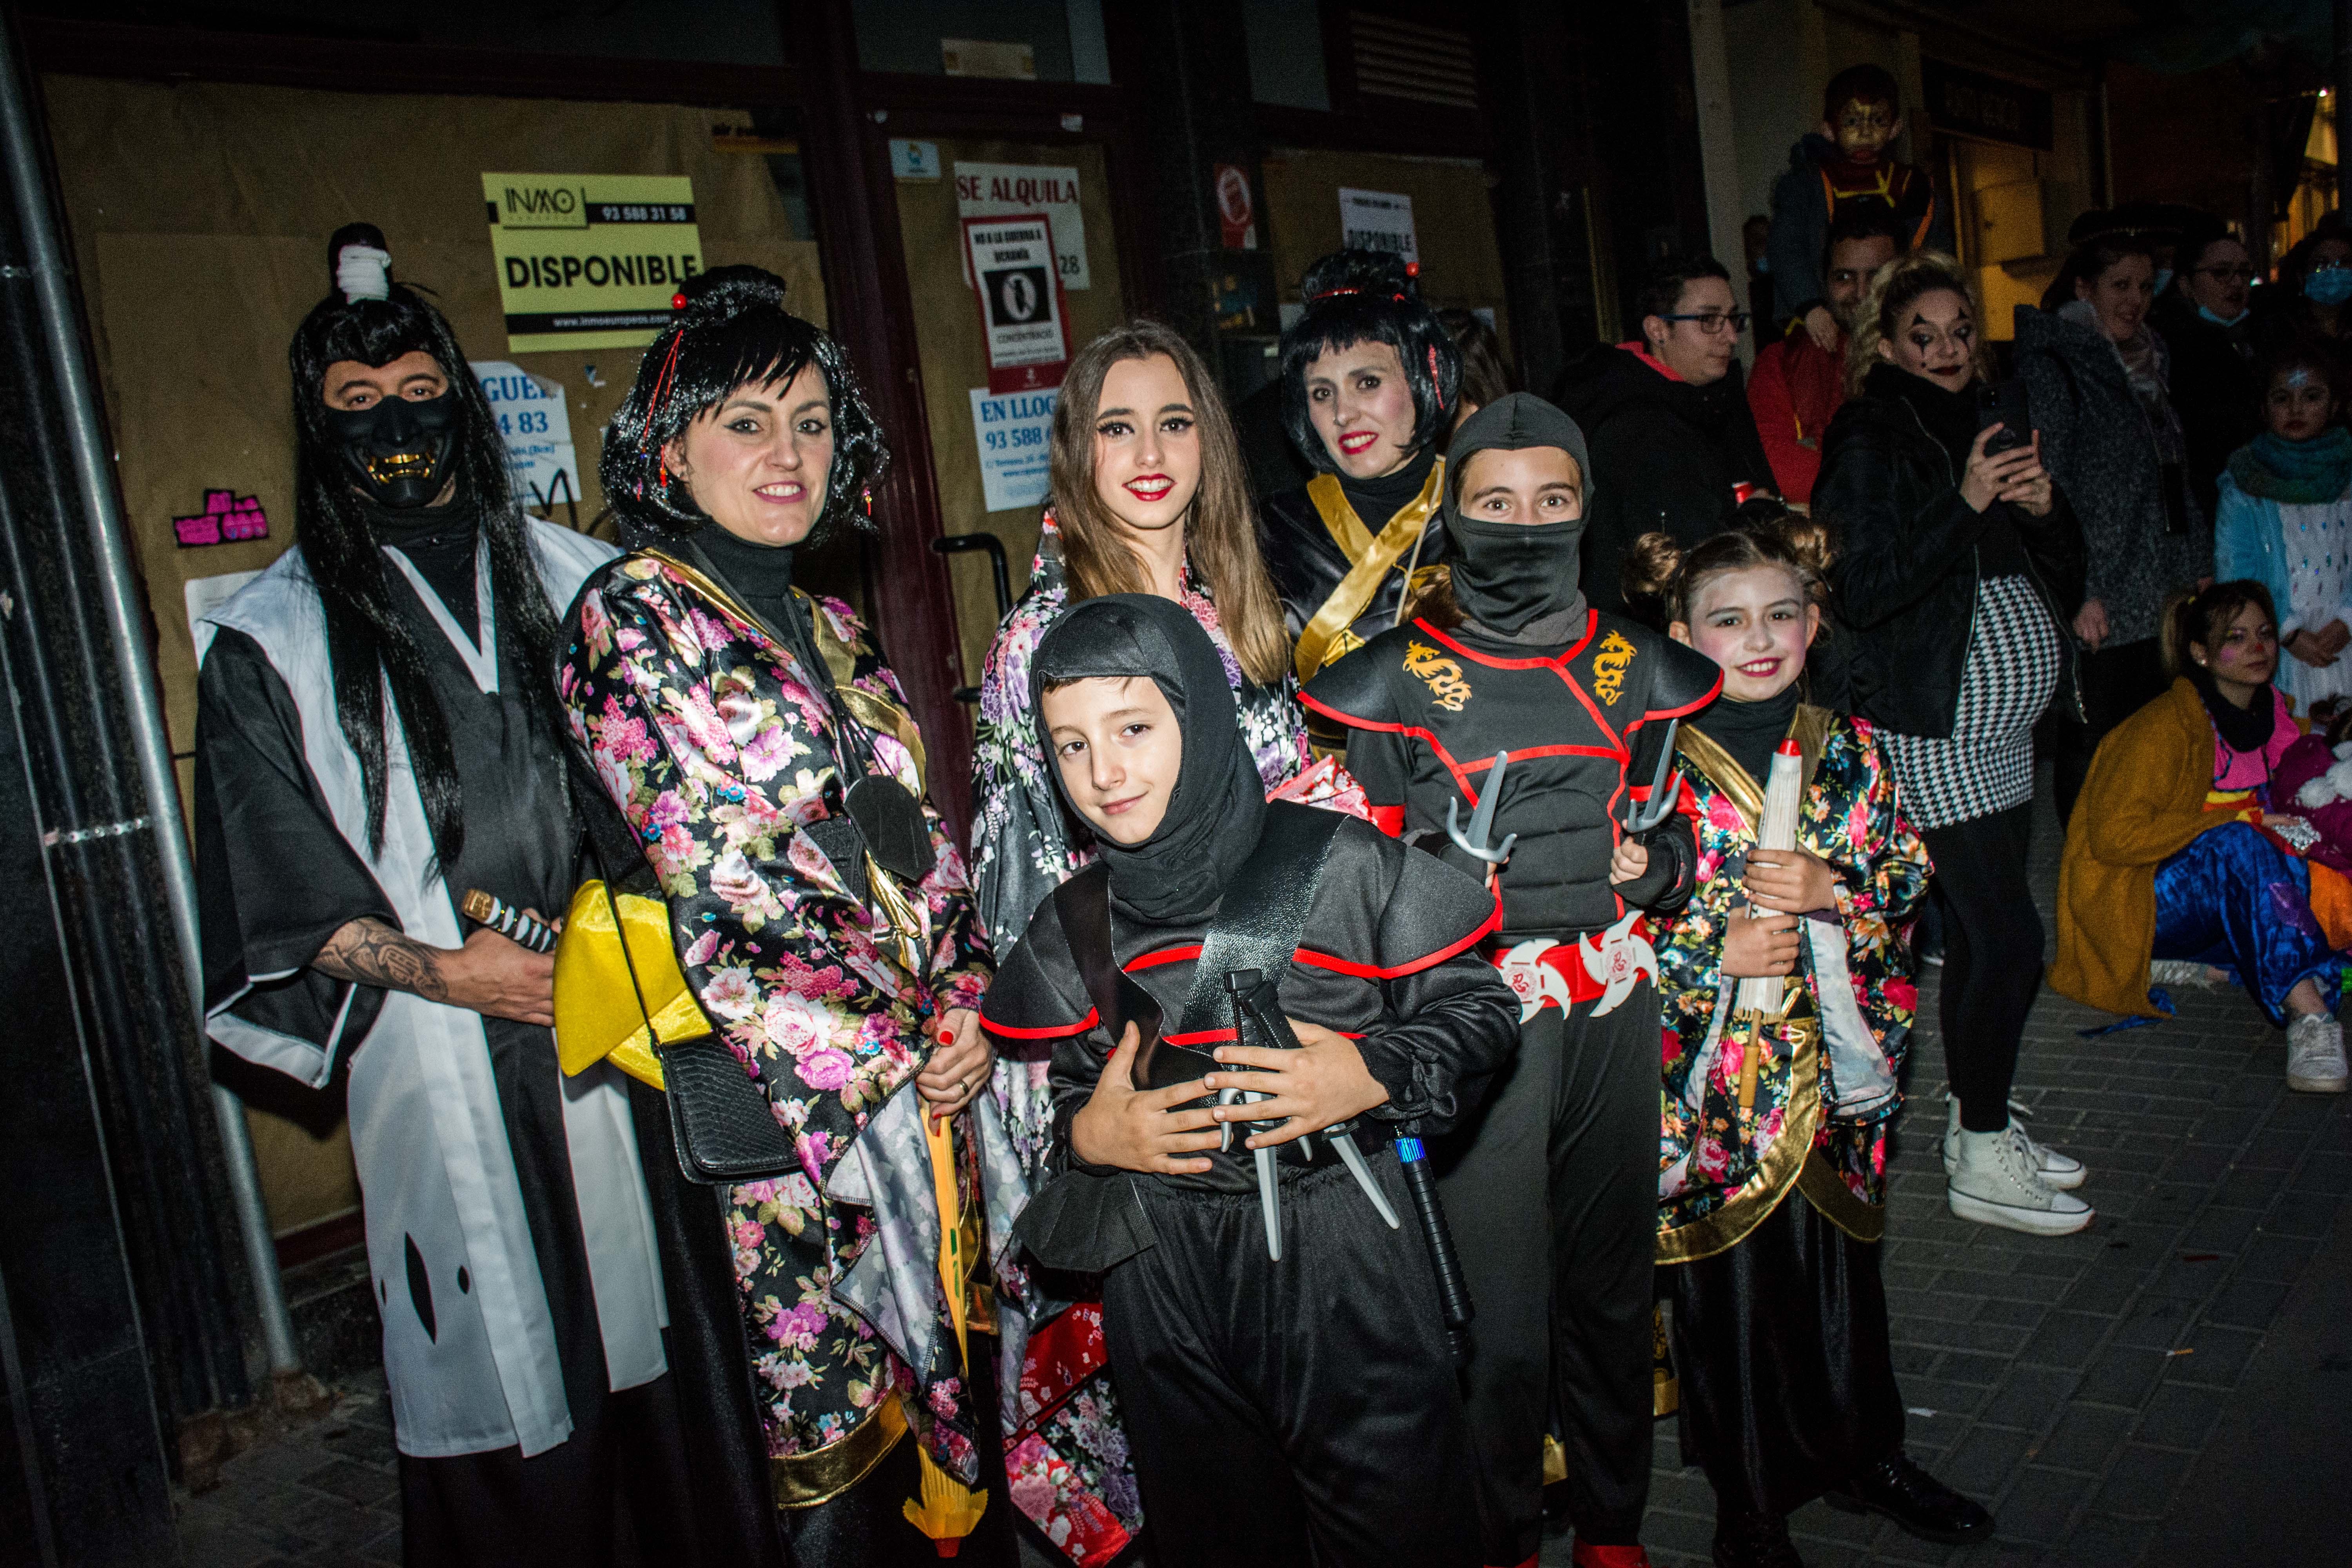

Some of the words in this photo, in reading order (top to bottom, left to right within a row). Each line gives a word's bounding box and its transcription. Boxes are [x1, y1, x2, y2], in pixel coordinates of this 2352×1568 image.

[505, 188, 575, 214] INMO
[957, 176, 983, 200] SE
[990, 178, 1078, 206] ALQUILA
[602, 206, 620, 221] 93
[623, 207, 648, 221] 588
[650, 207, 666, 221] 31
[506, 254, 697, 289] DISPONIBLE
[1060, 255, 1080, 275] 28
[518, 411, 549, 435] 83
[981, 400, 1006, 423] EN
[985, 431, 1007, 451] 93
[1011, 426, 1043, 449] 588
